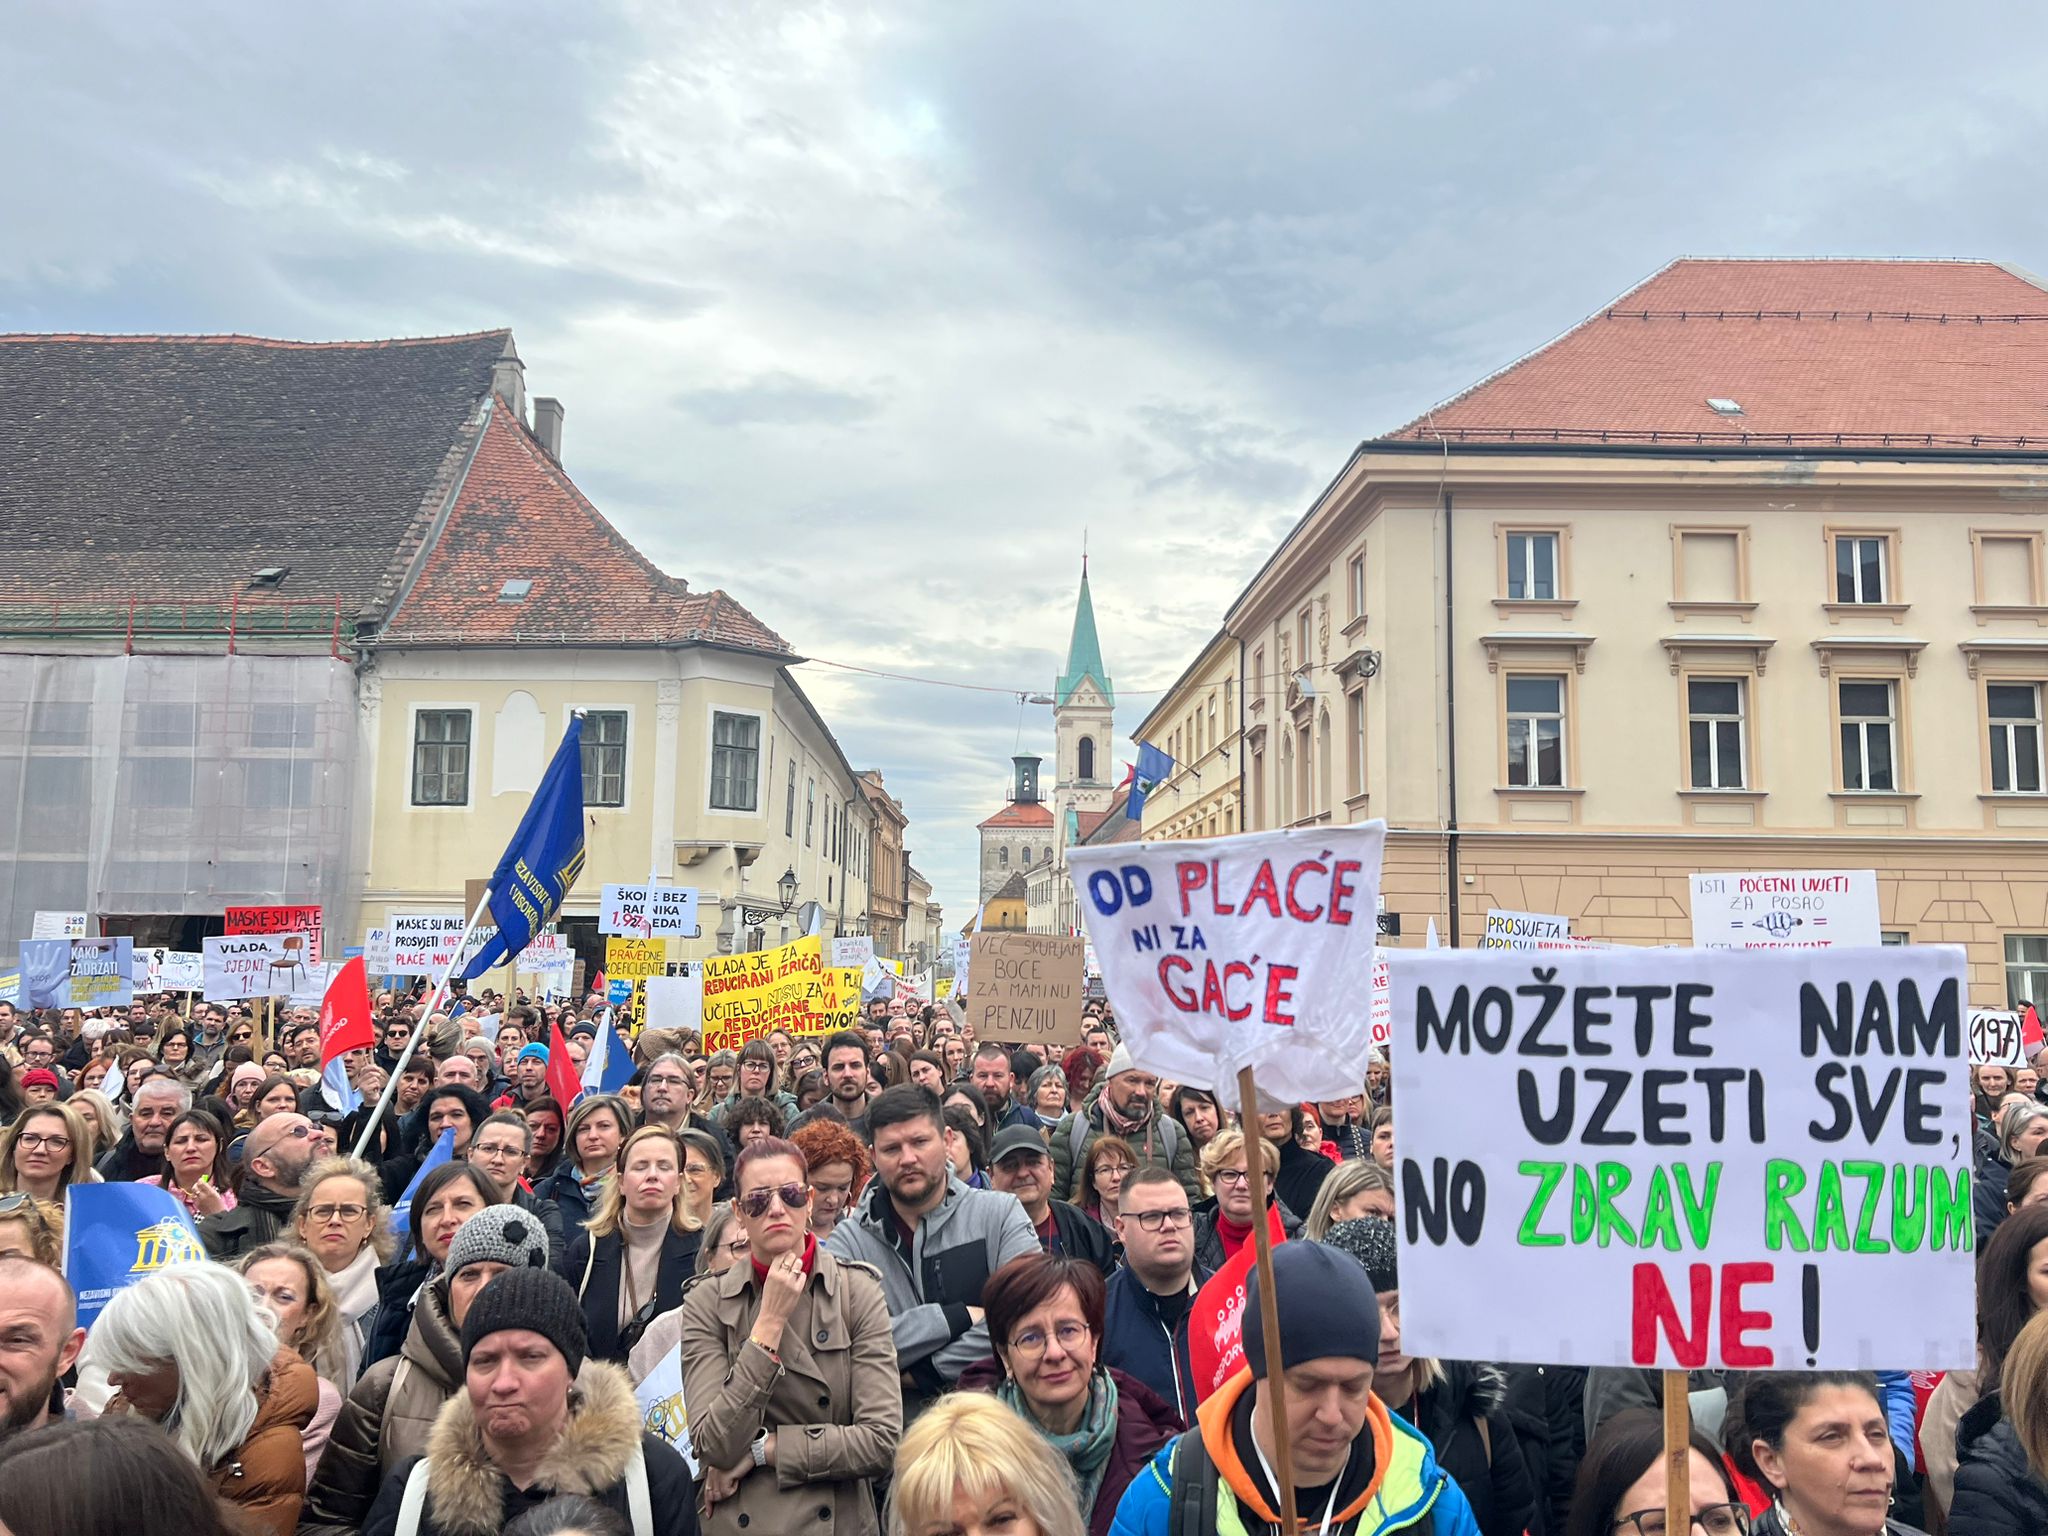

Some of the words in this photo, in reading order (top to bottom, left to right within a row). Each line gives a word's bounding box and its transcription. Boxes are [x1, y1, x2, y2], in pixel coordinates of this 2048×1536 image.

[1088, 864, 1153, 916] OD
[1175, 850, 1362, 926] PLAĆE
[1700, 879, 1725, 894] ISTI
[1802, 876, 1849, 893] UVJETI
[663, 893, 687, 903] BEZ
[1730, 896, 1753, 910] ZA
[1772, 896, 1825, 910] POSAO
[228, 911, 269, 927] MASKE
[272, 911, 289, 925] SU
[295, 910, 320, 926] PALE
[396, 919, 427, 930] MASKE
[430, 919, 441, 930] SU
[444, 919, 463, 930] PALE
[652, 919, 681, 928] EDA!
[1488, 916, 1561, 938] PROSVJETA
[396, 936, 438, 949] PROSVJETI
[443, 936, 462, 946] OPET
[626, 940, 646, 948] ZA
[978, 934, 1011, 956] VEĆ
[1024, 940, 1080, 959] SKUPLJAM
[1132, 925, 1162, 952] NI
[1170, 925, 1207, 951] ZA
[71, 947, 98, 960] KAKO
[220, 943, 272, 953] VLADA,
[609, 949, 662, 961] PRAVEDNE
[224, 958, 264, 973] SJEDNI
[396, 952, 426, 965] PLAĆE
[706, 959, 746, 976] VLADA
[751, 954, 770, 970] JE
[781, 946, 797, 963] ZA
[71, 960, 118, 976] ZADRŽATI
[605, 962, 665, 975] KOEFICIJENTE
[995, 959, 1042, 979] BOCE
[241, 975, 254, 993] 1!
[704, 969, 773, 996] REDUCIRANI
[976, 982, 999, 996] ZA
[1010, 983, 1070, 999] MAMINU
[1158, 954, 1298, 1026] GAĆE
[704, 998, 761, 1021] UČITELJI
[767, 983, 802, 1007] NISU
[806, 983, 823, 998] ZA
[724, 1000, 809, 1033] REDUCIRANE
[984, 1005, 1056, 1033] PENZIJU
[1416, 967, 1714, 1057] MOŽETE
[1800, 977, 1961, 1057] NAM
[1517, 1067, 1766, 1146] UZETI
[1809, 1065, 1960, 1159] SVE,
[1402, 1157, 1486, 1246] NO
[1517, 1160, 1723, 1252] ZDRAV
[1765, 1159, 1974, 1254] RAZUM
